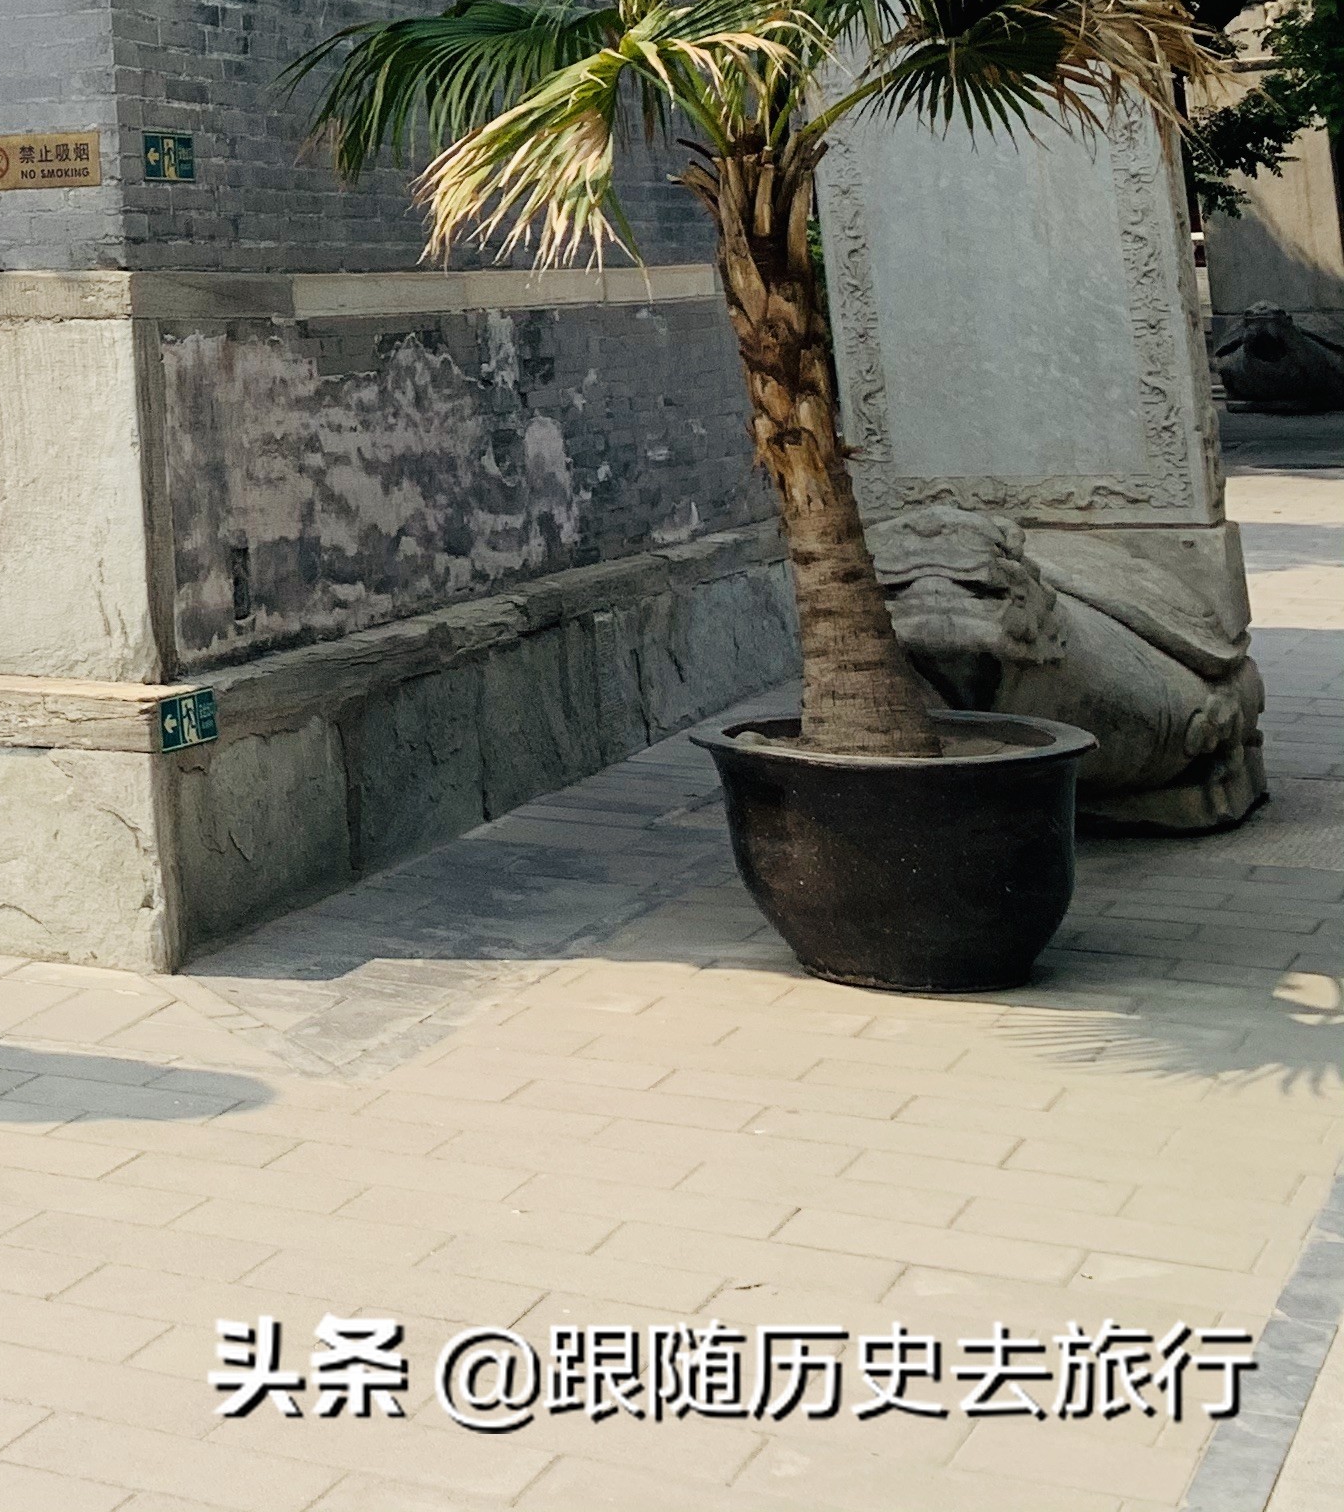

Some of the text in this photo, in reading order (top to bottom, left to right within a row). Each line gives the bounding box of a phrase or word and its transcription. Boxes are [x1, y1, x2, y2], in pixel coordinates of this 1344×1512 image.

[19, 143, 90, 164] 禁止吸烟
[20, 167, 90, 179] NO SMOKING
